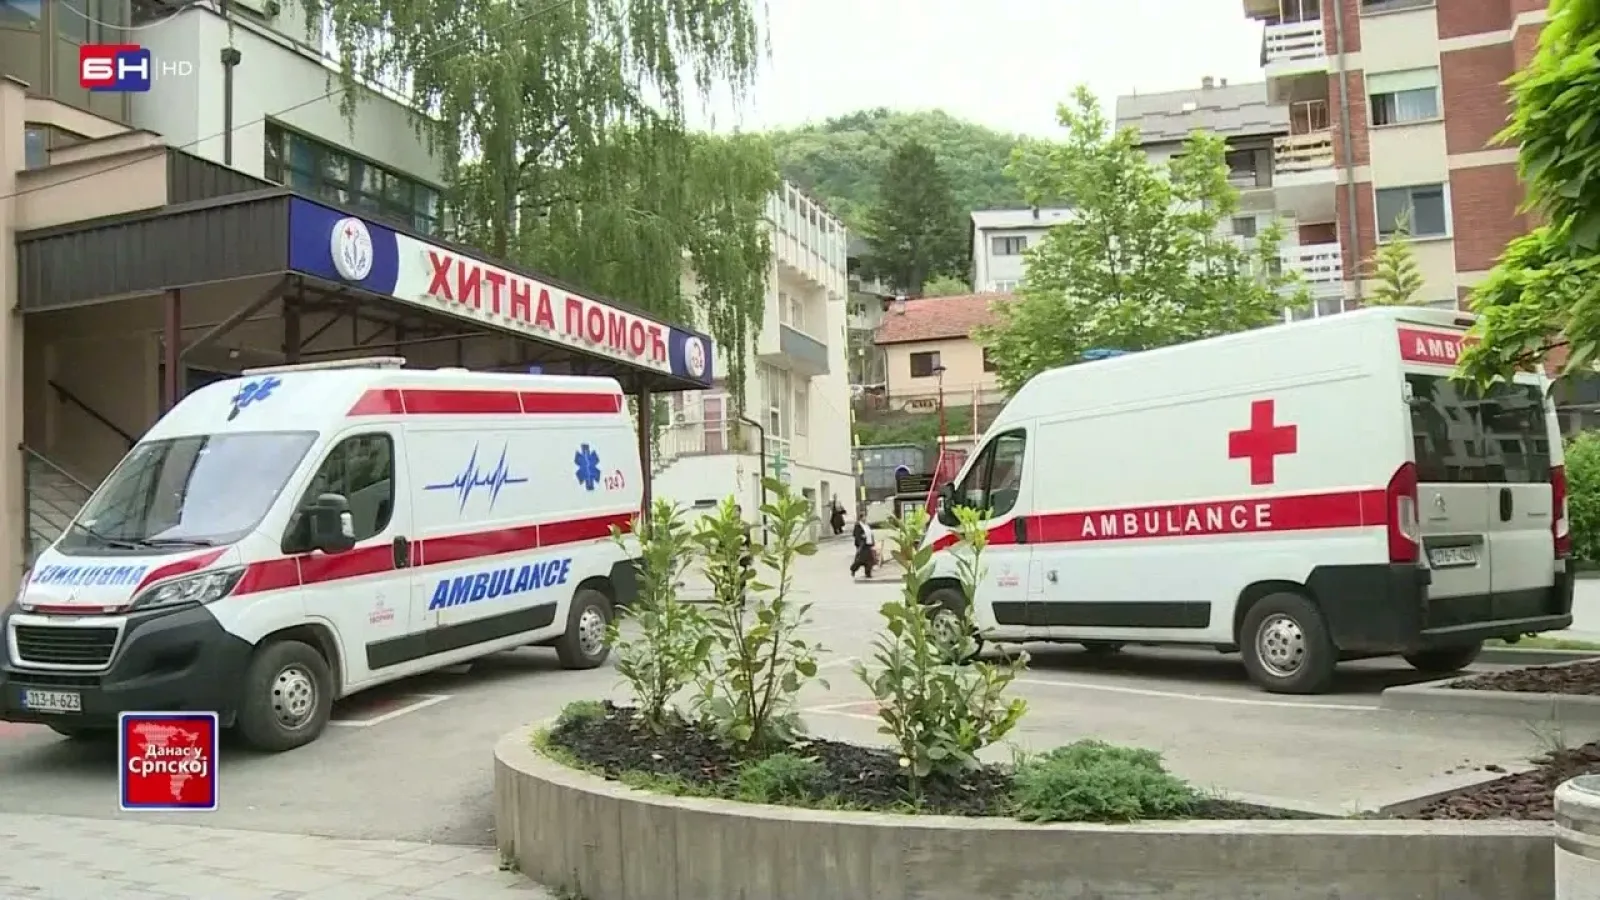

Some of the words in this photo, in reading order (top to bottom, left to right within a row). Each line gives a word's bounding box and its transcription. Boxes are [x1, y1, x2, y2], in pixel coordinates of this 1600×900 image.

[427, 250, 556, 331] ХИТНА
[565, 296, 667, 363] ПОМОЋ
[604, 475, 620, 490] 124
[1081, 503, 1272, 537] AMBULANCE
[428, 558, 573, 611] AMBULANCE
